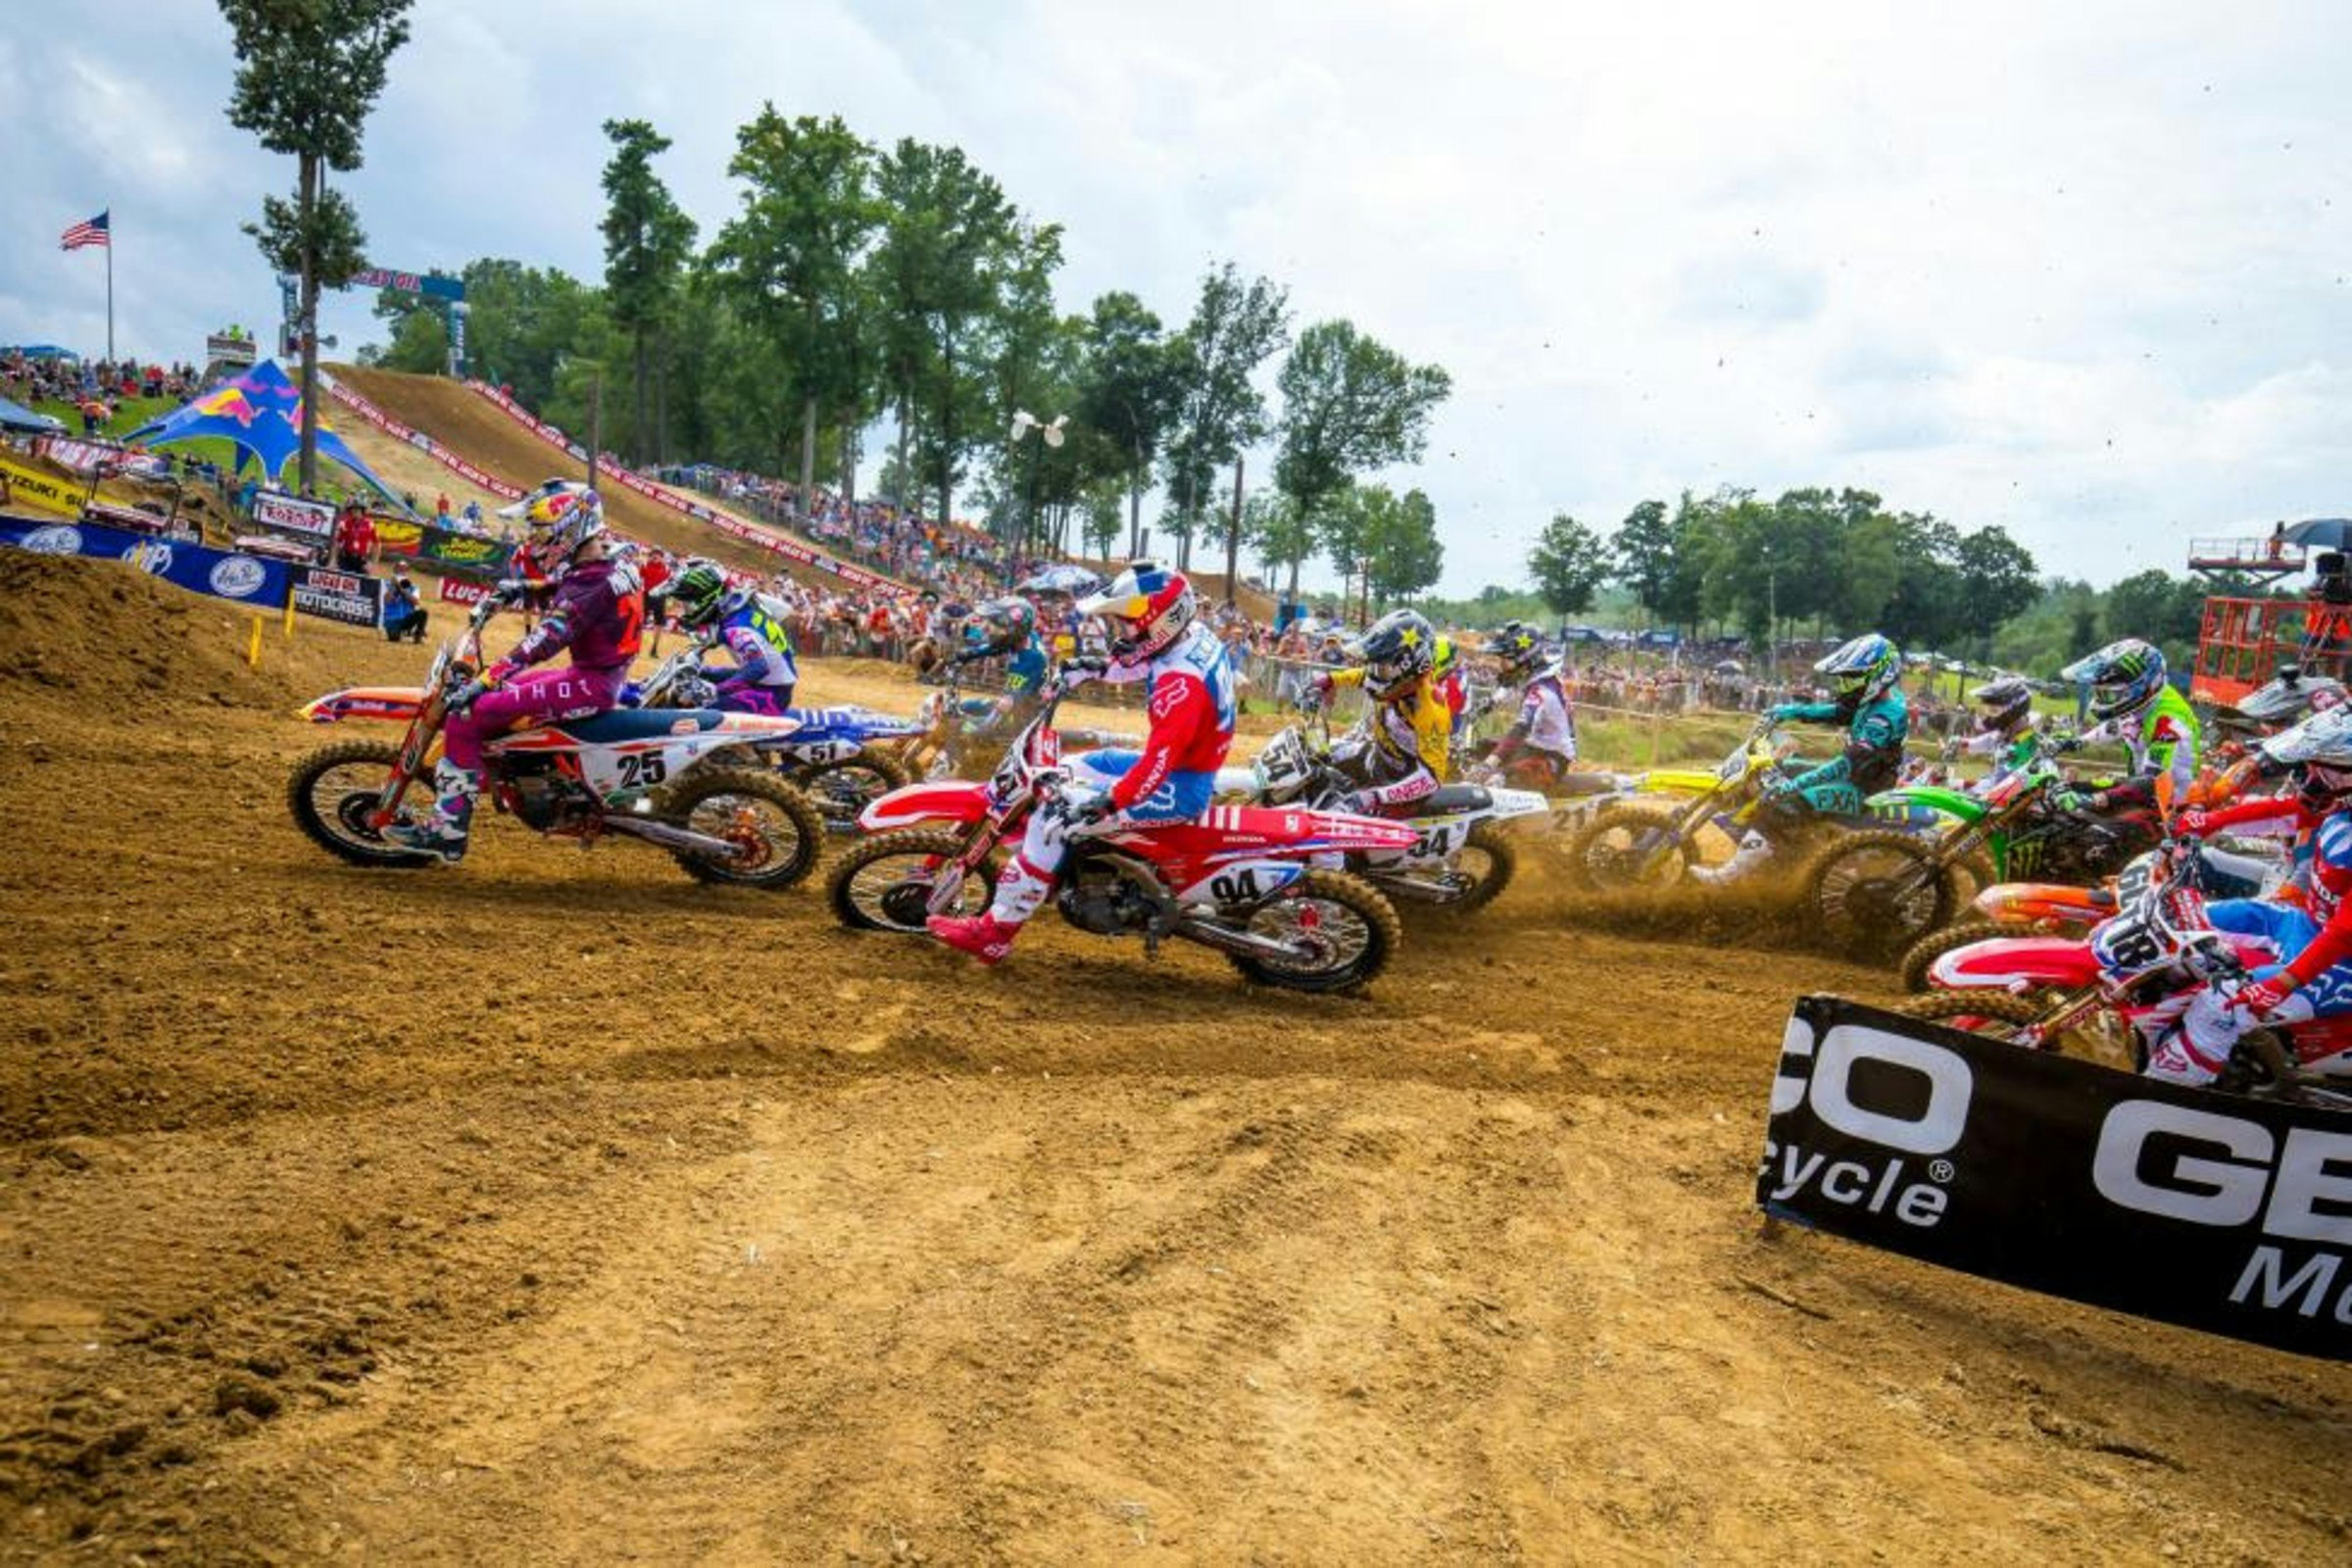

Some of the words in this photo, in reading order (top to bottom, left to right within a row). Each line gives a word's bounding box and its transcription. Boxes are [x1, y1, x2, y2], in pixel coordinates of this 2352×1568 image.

[445, 586, 492, 604] LUCA
[616, 750, 666, 788] 25
[1210, 867, 1262, 905] 94
[2108, 923, 2160, 967] 18
[1771, 1015, 1975, 1156] O
[2092, 1099, 2352, 1245] GE
